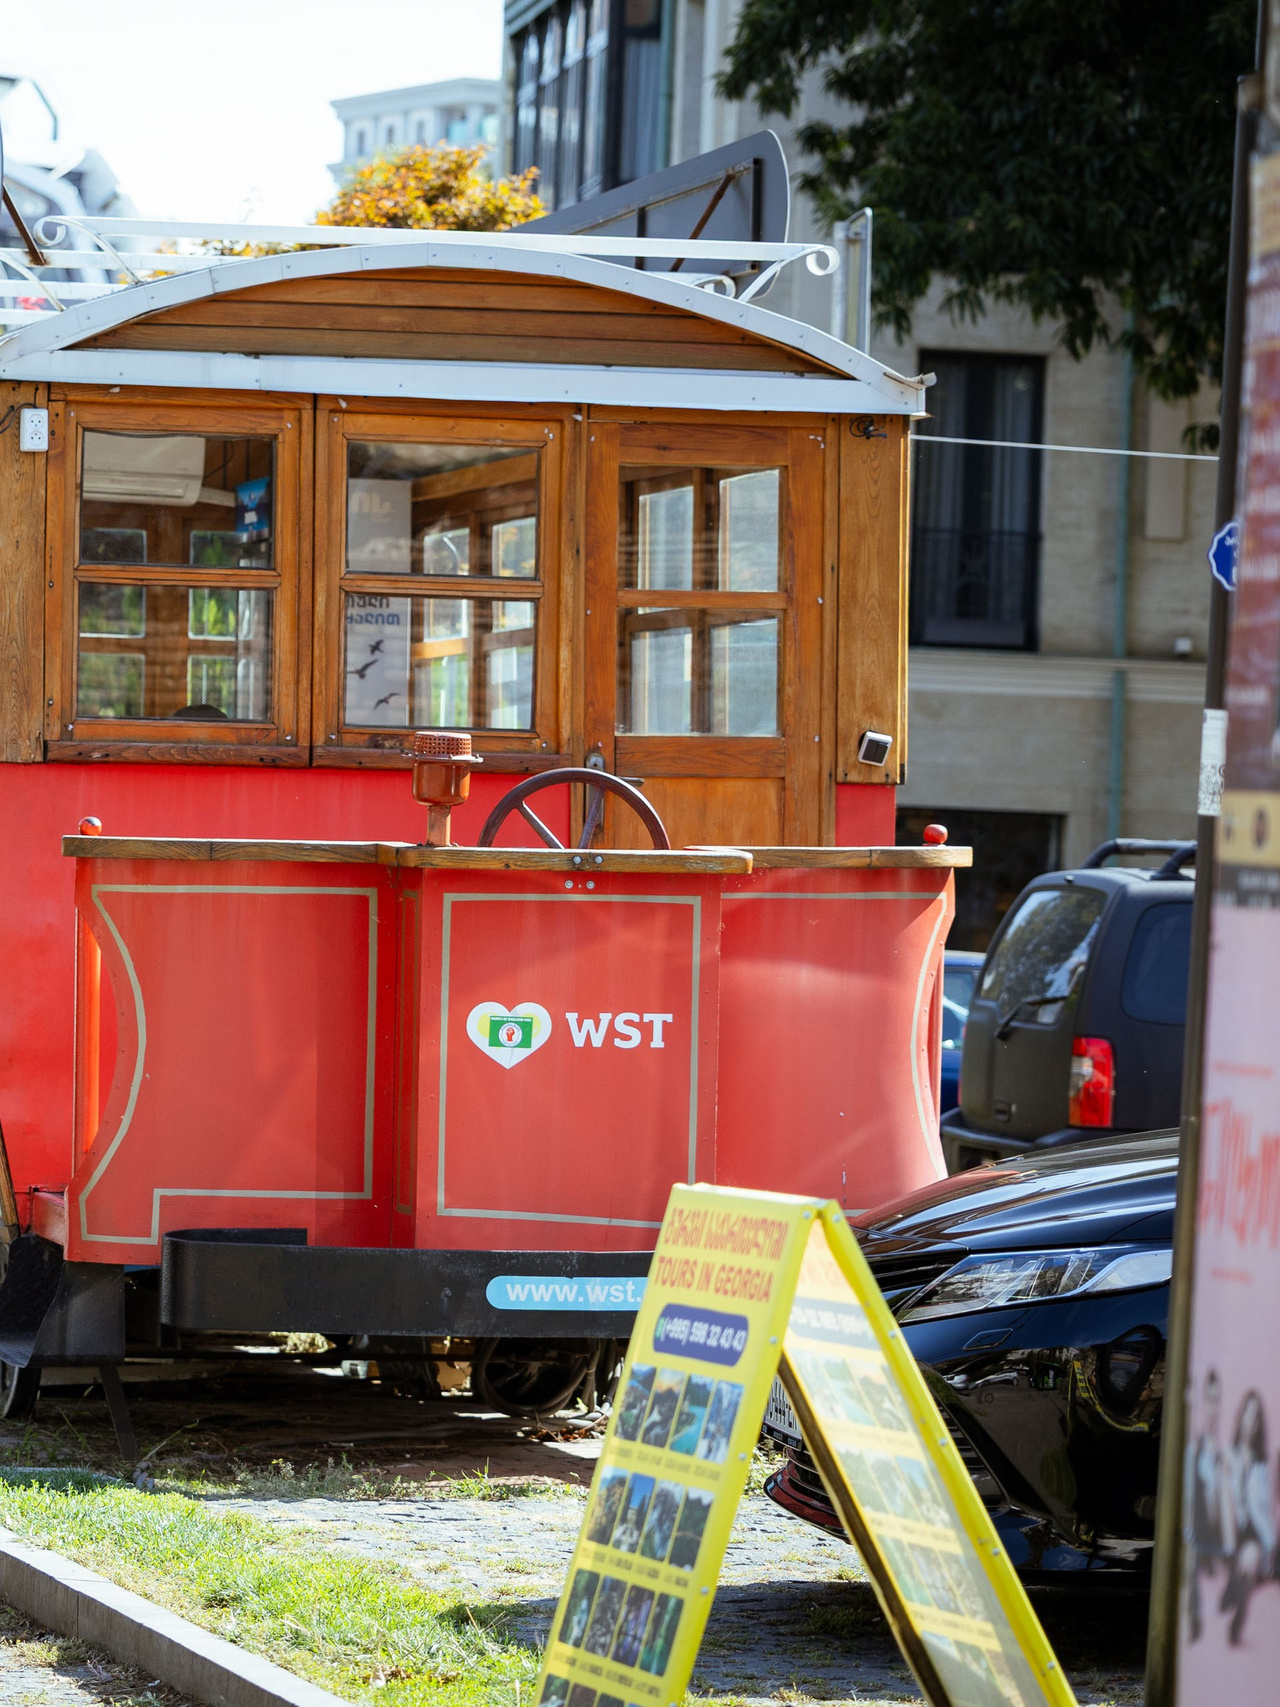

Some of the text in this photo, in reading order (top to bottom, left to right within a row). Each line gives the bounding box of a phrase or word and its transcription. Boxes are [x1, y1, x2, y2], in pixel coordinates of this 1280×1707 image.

[565, 1012, 673, 1049] WST
[655, 1256, 697, 1289] TOURS
[696, 1261, 715, 1292] IN
[715, 1266, 773, 1302] GEORGIA
